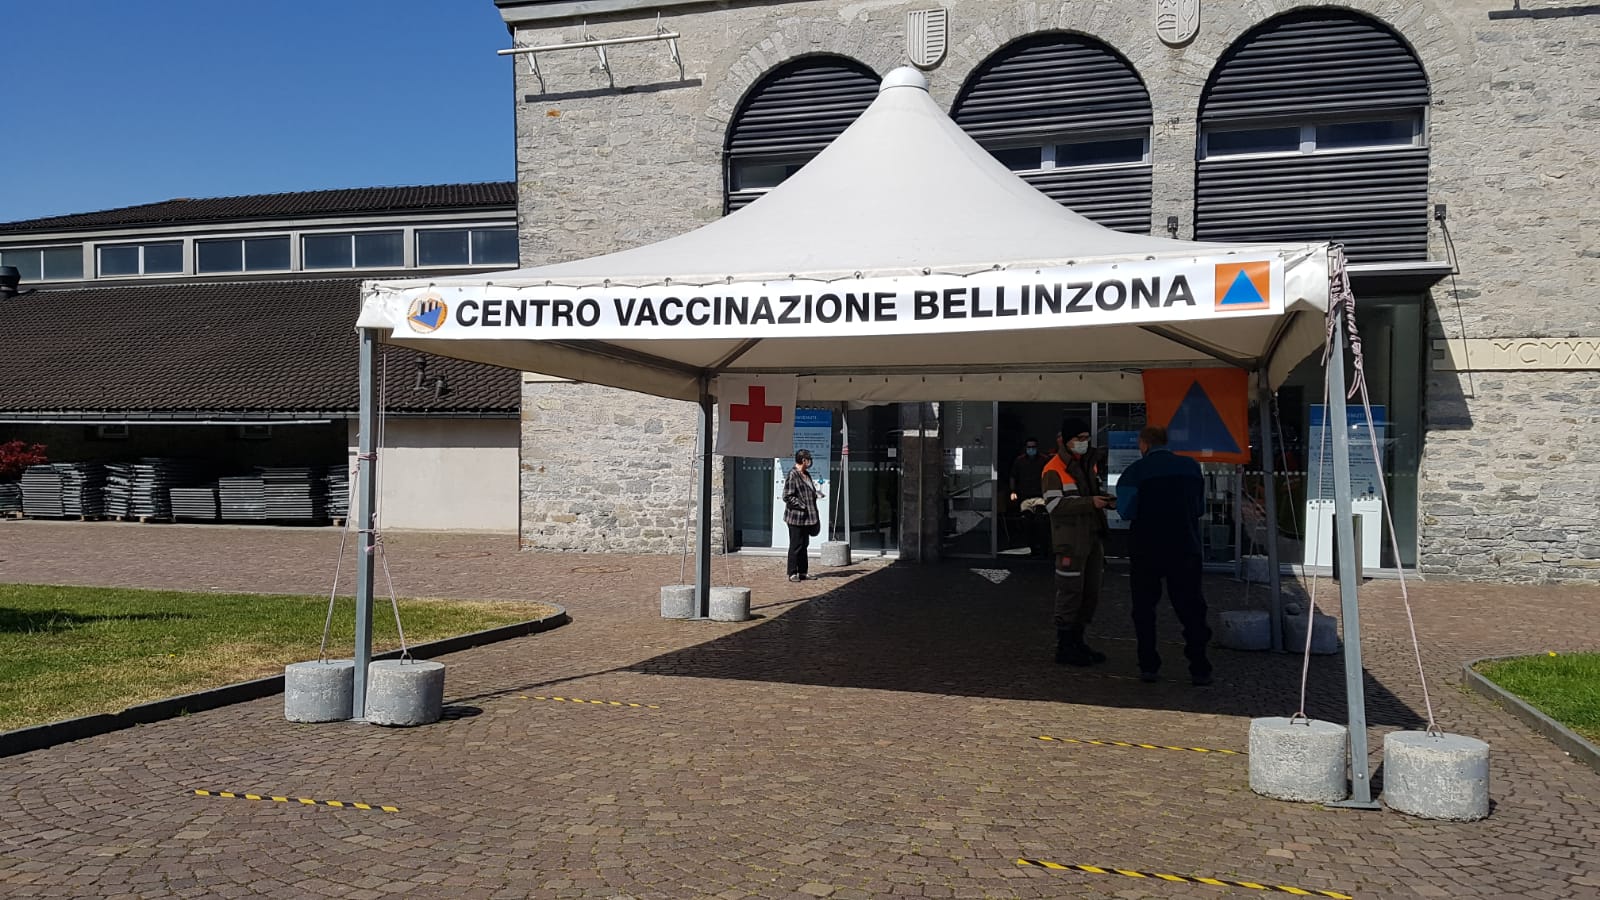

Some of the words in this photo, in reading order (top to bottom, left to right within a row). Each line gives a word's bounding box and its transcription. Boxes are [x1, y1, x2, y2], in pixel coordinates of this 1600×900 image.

[455, 298, 601, 327] CENTRO
[613, 290, 898, 327] VACCINAZIONE
[914, 274, 1195, 321] BELLINZONA
